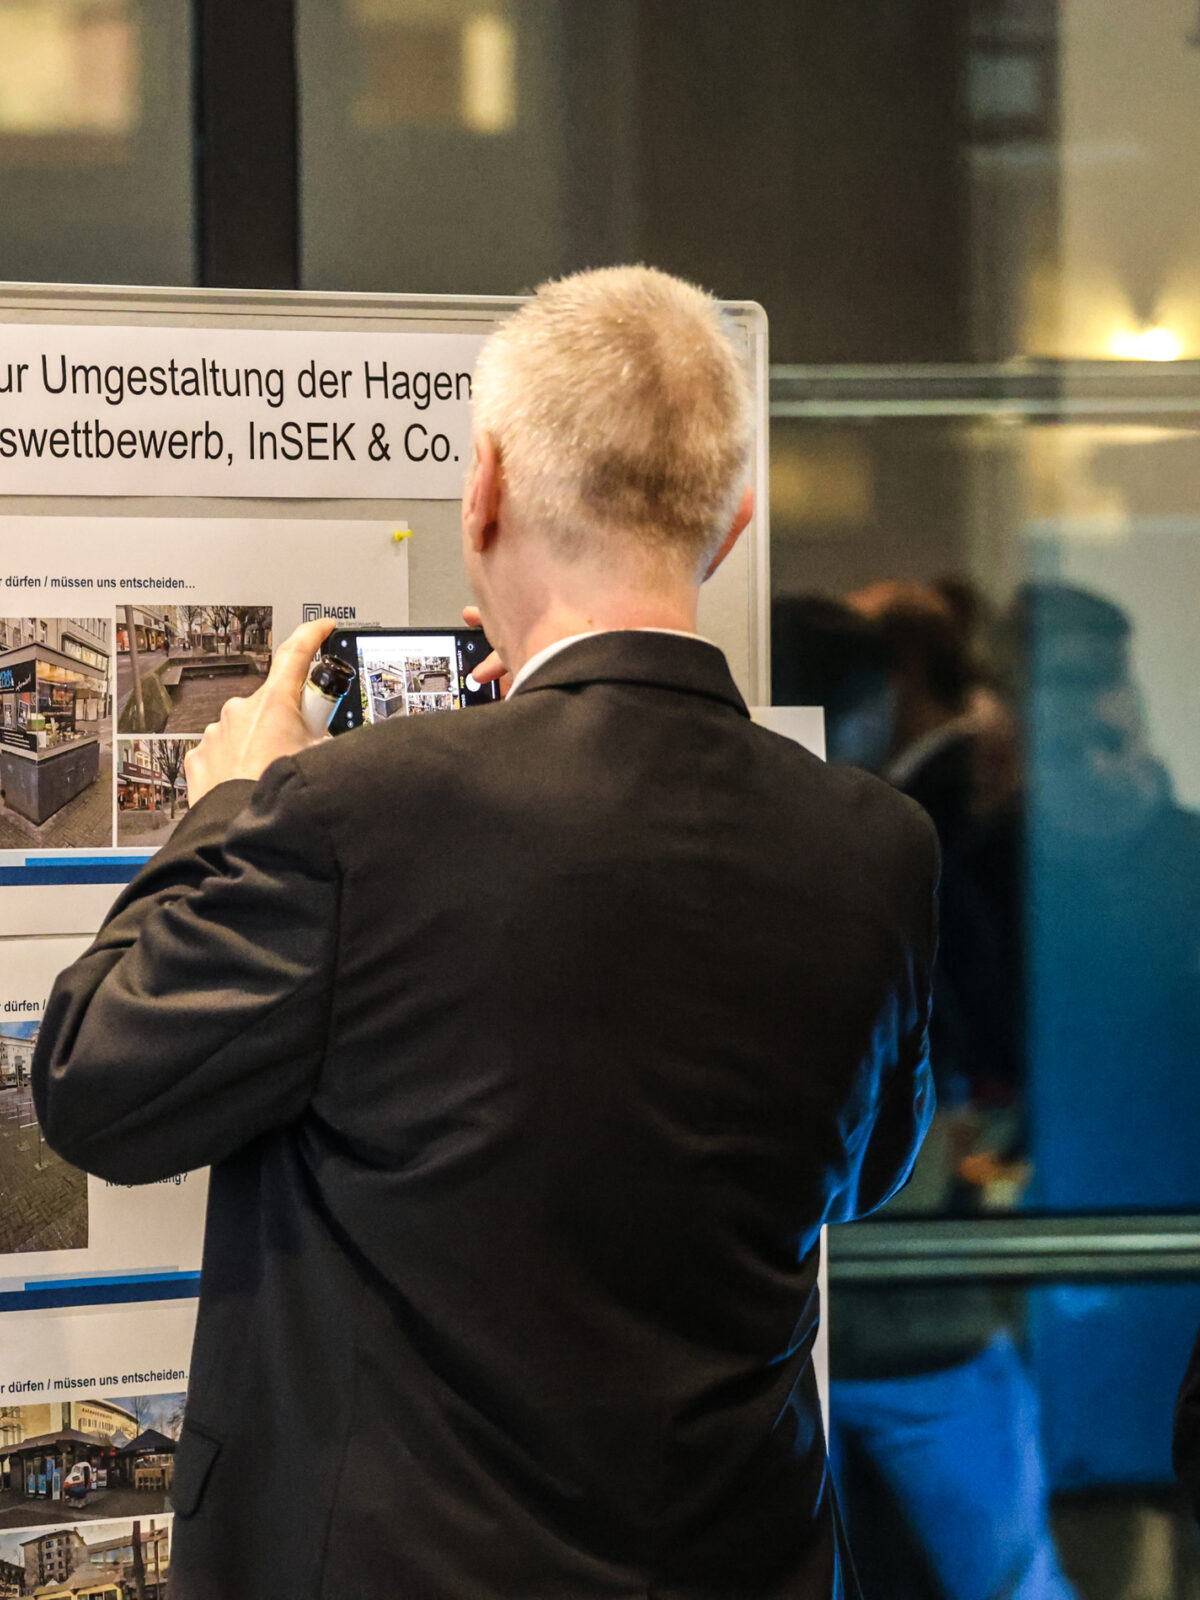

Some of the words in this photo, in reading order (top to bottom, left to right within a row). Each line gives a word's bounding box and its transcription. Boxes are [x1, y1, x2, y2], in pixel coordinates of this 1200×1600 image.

[41, 354, 285, 408] Umgestaltung
[299, 360, 353, 398] der
[248, 421, 356, 461] InSEK
[367, 423, 391, 462] &
[404, 423, 460, 462] Co.
[5, 576, 41, 588] dürfen
[43, 576, 48, 588] /
[50, 577, 94, 588] müssen
[97, 578, 116, 588] uns
[119, 577, 196, 589] entscheiden...
[323, 606, 356, 619] HAGEN
[4, 999, 40, 1012] dürfen
[8, 1379, 44, 1394] dürfen
[47, 1378, 51, 1391] /
[54, 1377, 96, 1390] müssen
[99, 1376, 119, 1386] uns
